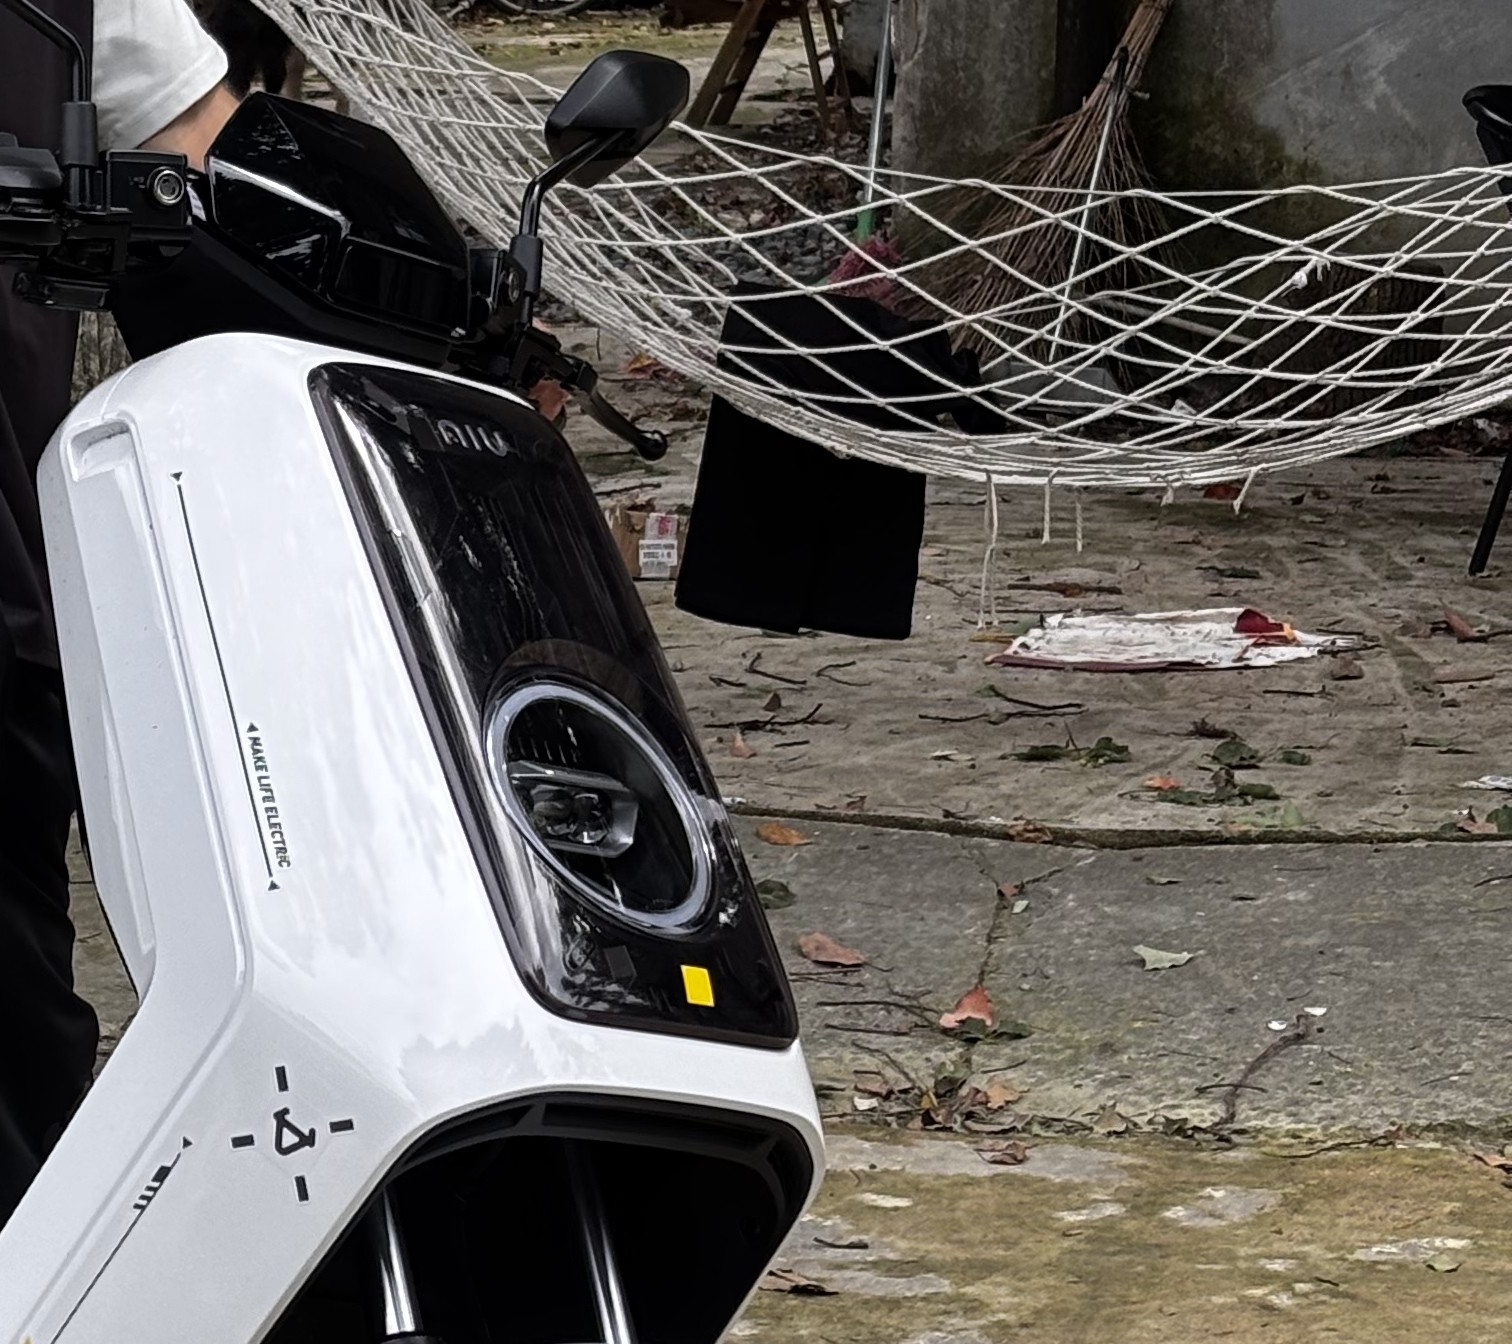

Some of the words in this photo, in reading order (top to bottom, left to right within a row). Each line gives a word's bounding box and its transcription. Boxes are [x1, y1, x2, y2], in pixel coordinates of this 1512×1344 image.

[248, 736, 268, 772] MAKE
[256, 775, 277, 804] LIFE
[264, 806, 291, 868] ELECTRIC
